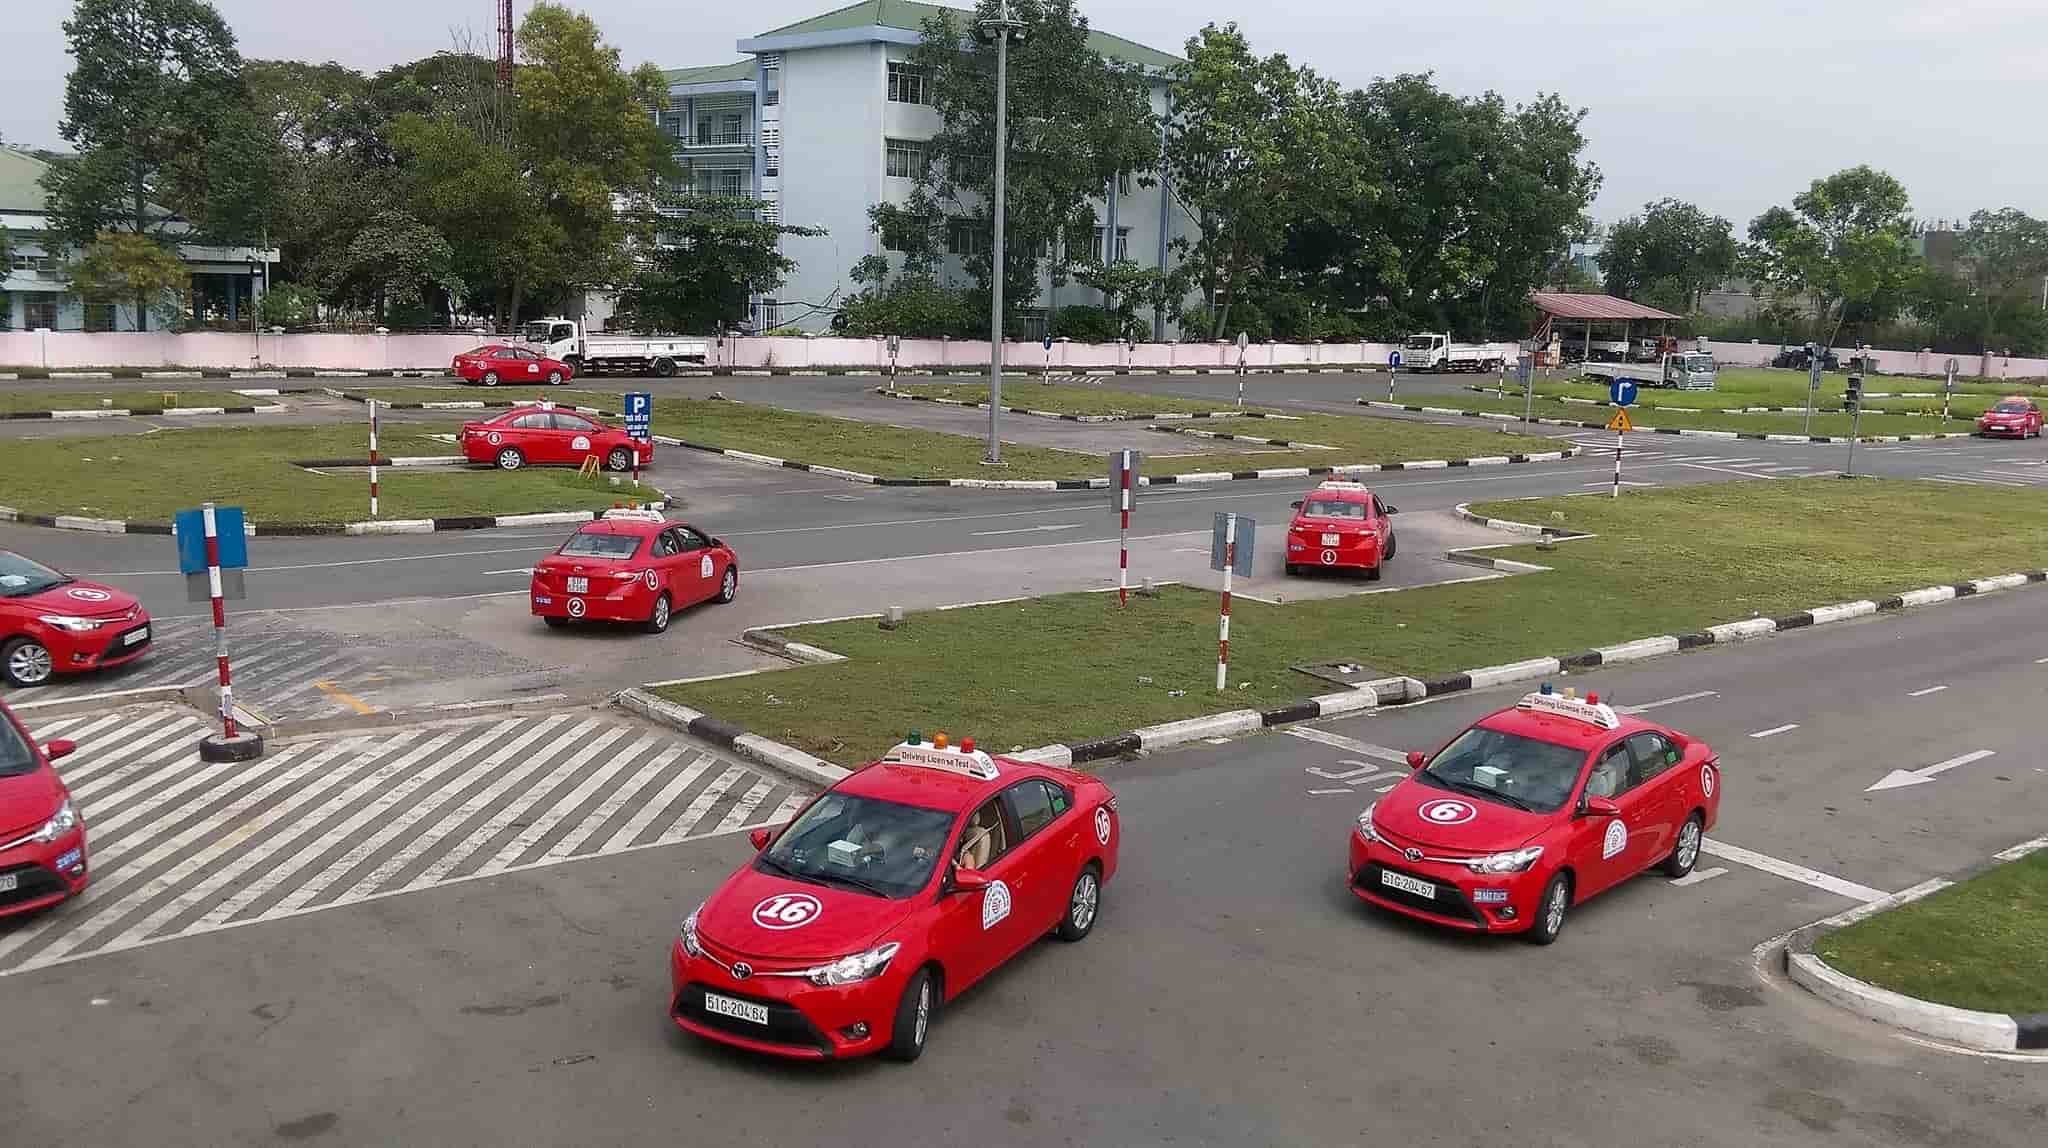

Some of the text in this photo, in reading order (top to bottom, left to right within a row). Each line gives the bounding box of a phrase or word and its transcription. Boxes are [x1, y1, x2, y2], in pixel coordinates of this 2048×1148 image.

[633, 396, 645, 413] P
[902, 751, 926, 762] Driving
[927, 754, 954, 766] License
[955, 758, 969, 769] Test
[1430, 803, 1465, 820] 6
[1097, 813, 1109, 839] 16
[758, 898, 815, 922] 16
